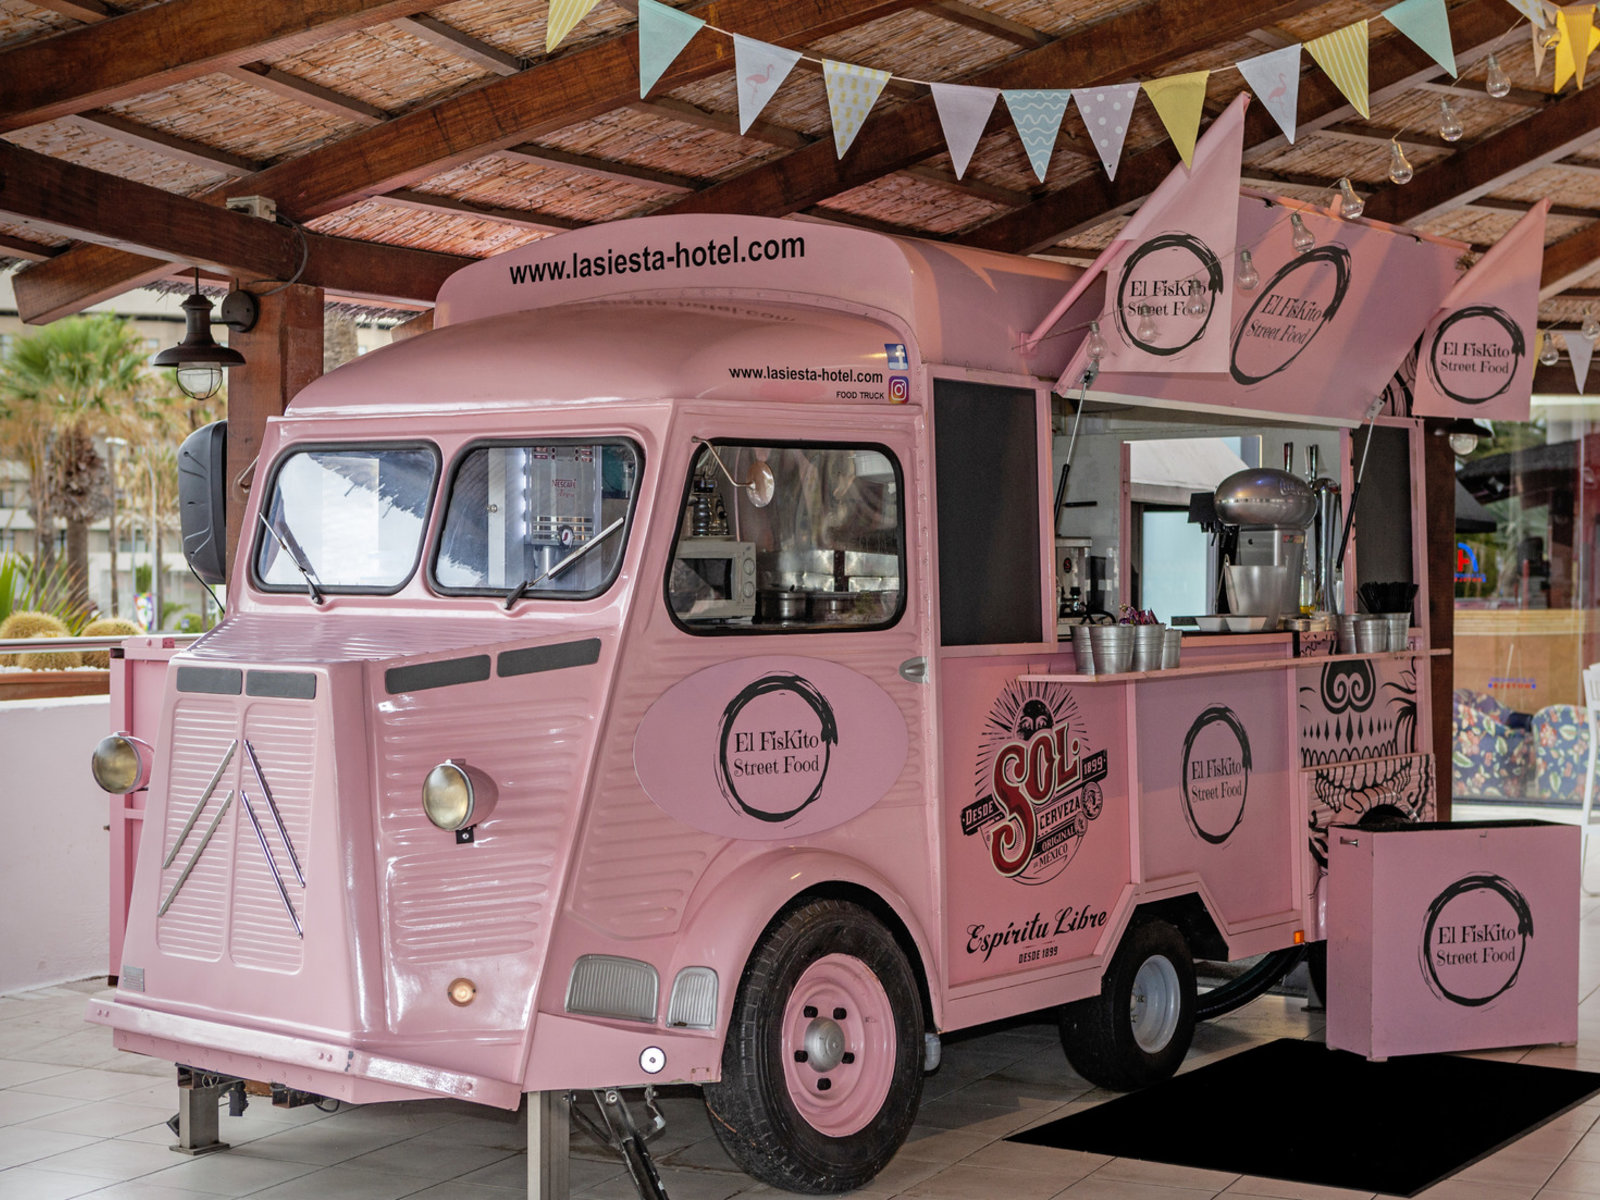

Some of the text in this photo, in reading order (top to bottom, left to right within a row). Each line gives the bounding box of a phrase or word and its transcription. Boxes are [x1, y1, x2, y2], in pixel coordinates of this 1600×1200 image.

[509, 236, 806, 284] www.lasiesta-hotel.com
[1129, 279, 1206, 298] El FisKio
[1260, 294, 1322, 322] El FisKito
[1246, 319, 1312, 344] Street Food
[1443, 342, 1510, 358] El FisKito
[729, 366, 883, 383] www.lasiesta-hotel.com
[1440, 360, 1509, 374] Street Food
[836, 391, 884, 400] FOOD TRUCK
[734, 729, 819, 753] El FisKito
[733, 755, 819, 777] Street Food
[1083, 756, 1103, 775] 1899
[1192, 757, 1242, 780] El FisKito
[1191, 780, 1242, 803] Street Food
[1039, 796, 1081, 830] CERVEZA
[1041, 824, 1077, 852] ORIGINAL
[966, 905, 1107, 964] Espíritu Libre
[1438, 923, 1517, 945] El FisKito
[1018, 946, 1059, 964] DESDE 1899
[1436, 946, 1516, 967] Street Food
